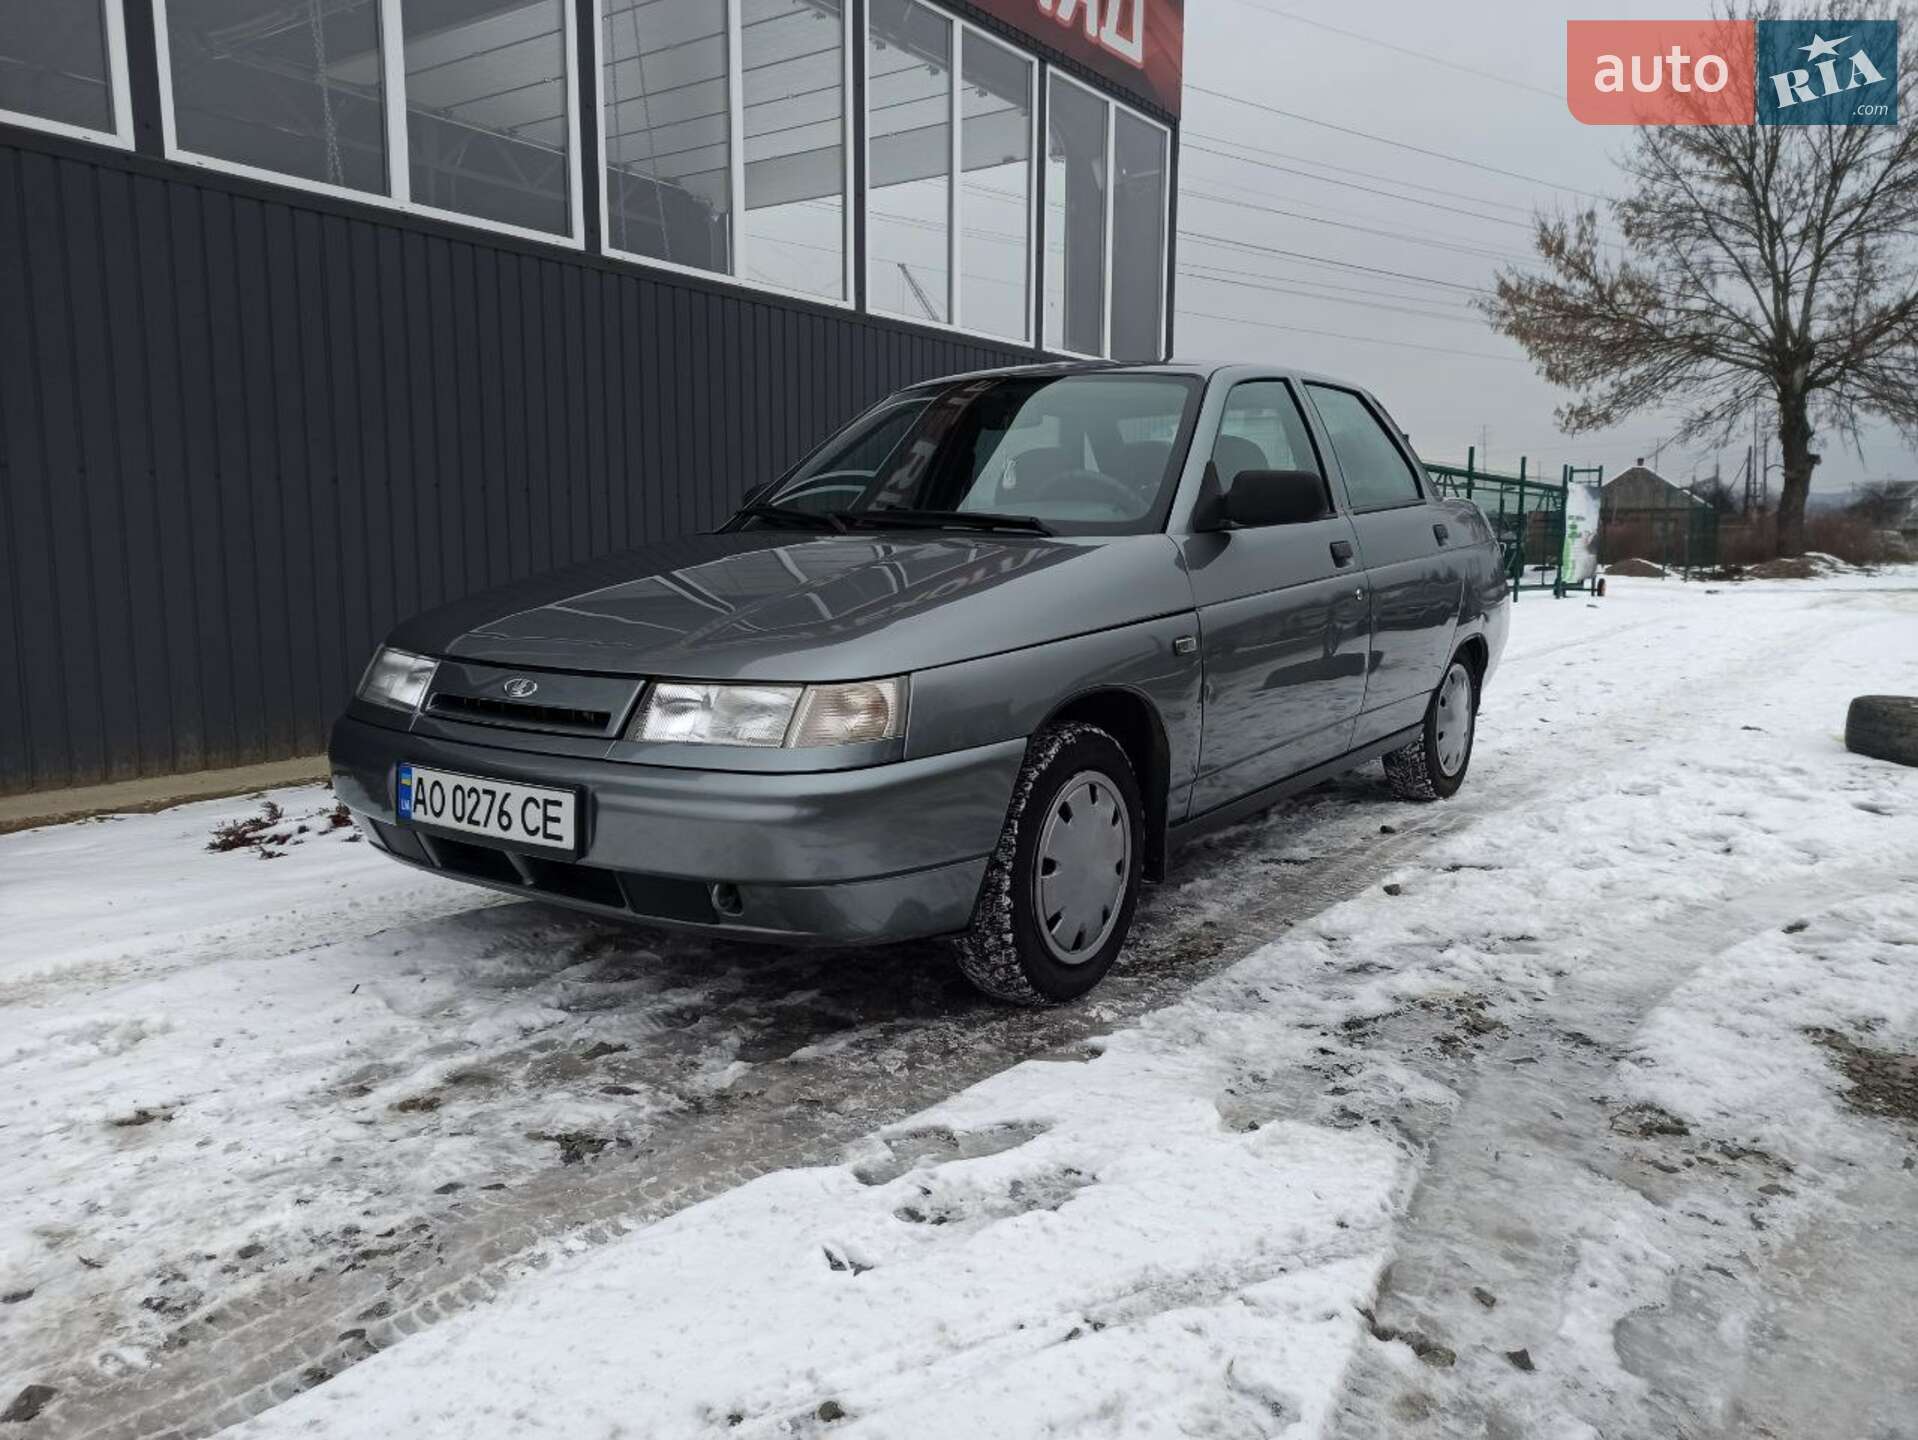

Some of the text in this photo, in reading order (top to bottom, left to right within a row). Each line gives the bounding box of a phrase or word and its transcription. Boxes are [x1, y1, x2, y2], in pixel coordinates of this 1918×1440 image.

[413, 777, 563, 842] AO 0276 CE
